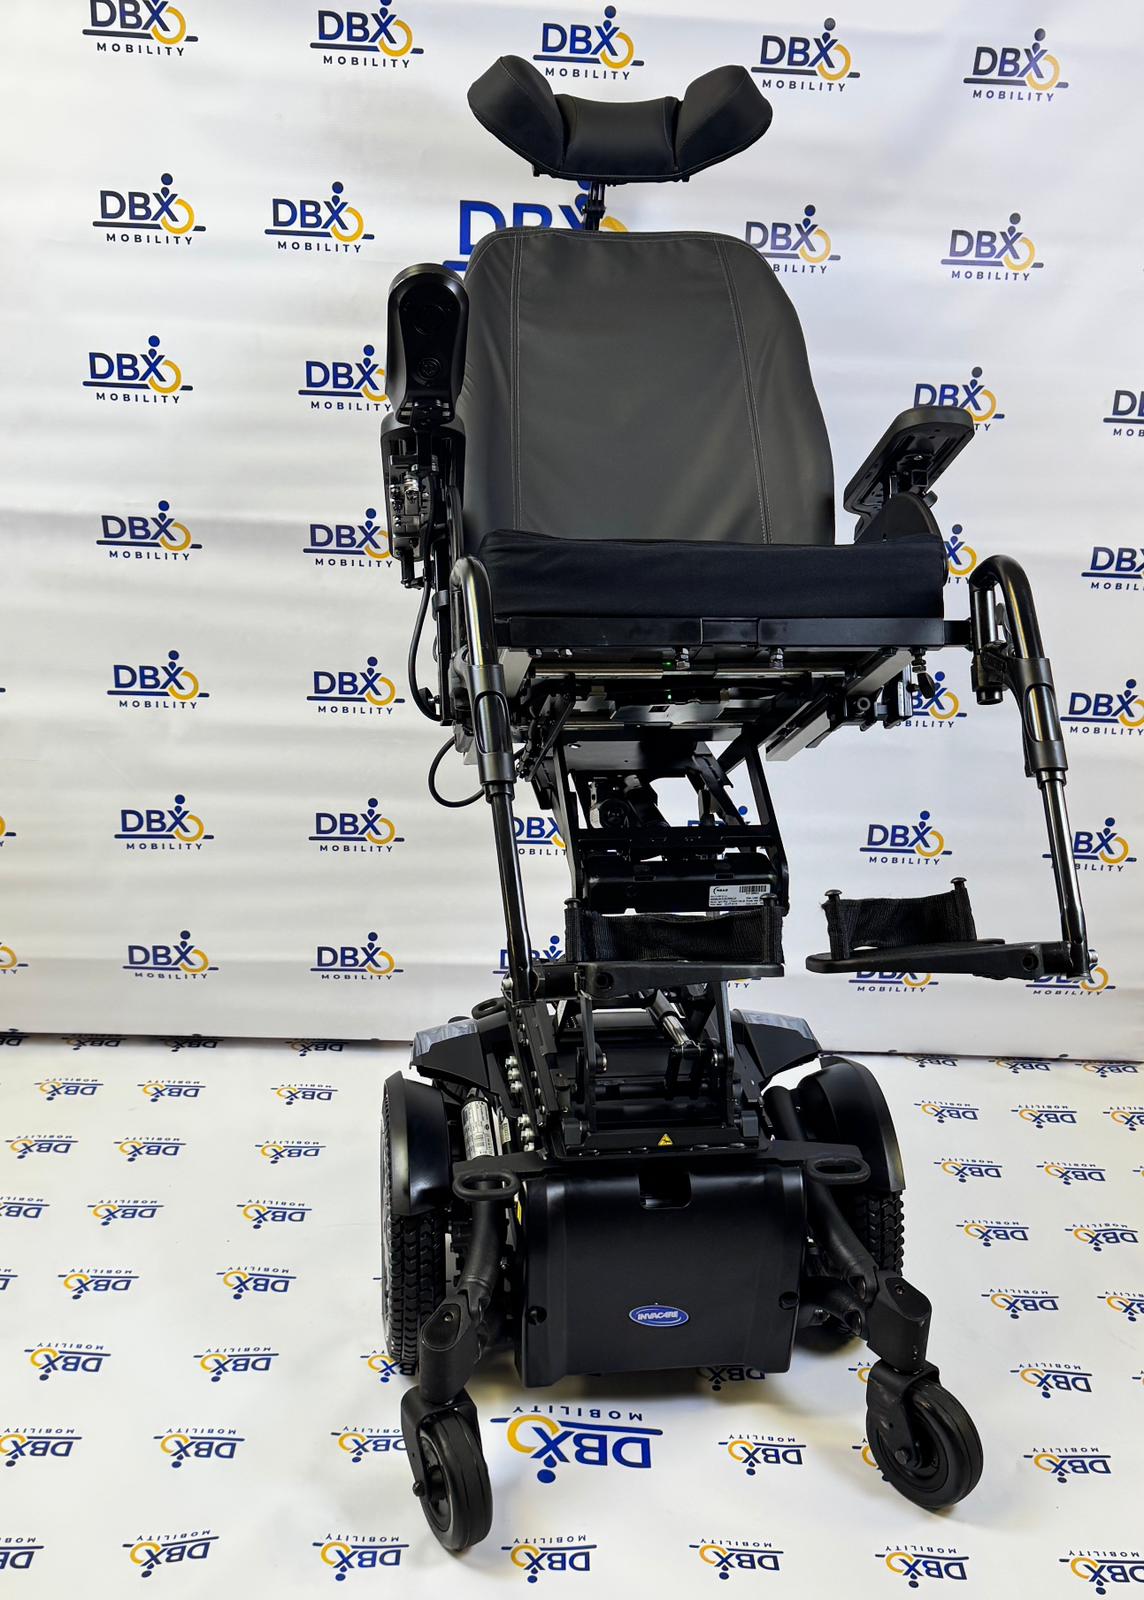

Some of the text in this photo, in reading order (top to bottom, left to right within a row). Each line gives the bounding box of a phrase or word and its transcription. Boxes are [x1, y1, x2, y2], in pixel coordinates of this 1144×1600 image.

[97, 42, 184, 56] MOBILITY
[323, 55, 409, 68] MOBILITY
[545, 67, 630, 80] MOBILITY
[762, 79, 845, 92] MOBILITY
[972, 89, 1054, 102] MOBILITY
[106, 233, 192, 245] MOBILITY
[278, 241, 361, 253] MOBILITY
[773, 263, 827, 275] BILITY
[951, 270, 1030, 281] MOBILITY
[96, 392, 179, 404] MOBILITY
[311, 400, 391, 412] MOBILITY
[109, 550, 189, 561] MOBILITY
[1090, 547, 1144, 573] DB
[315, 558, 392, 568] MOBILITY
[1090, 580, 1144, 591] MOBIL
[119, 700, 197, 709] MOBILITY
[318, 706, 393, 715] MOBILITY
[1069, 725, 1144, 737] MOBILITY
[1074, 831, 1117, 855] BX
[869, 856, 940, 865] MOBILITY
[135, 972, 207, 980] MOBILITY
[637, 1310, 679, 1320] INVACARE
[513, 1405, 642, 1421] MOBILITY
[343, 1426, 401, 1434] OBILITY
[729, 1434, 795, 1442] MOBILITY
[137, 1530, 210, 1541] MOBILITY
[326, 1533, 399, 1542] MOBILITY
[513, 1535, 586, 1544] MOBILITY
[701, 1539, 772, 1548] MOBILITY
[886, 1545, 957, 1554] MOBILITY
